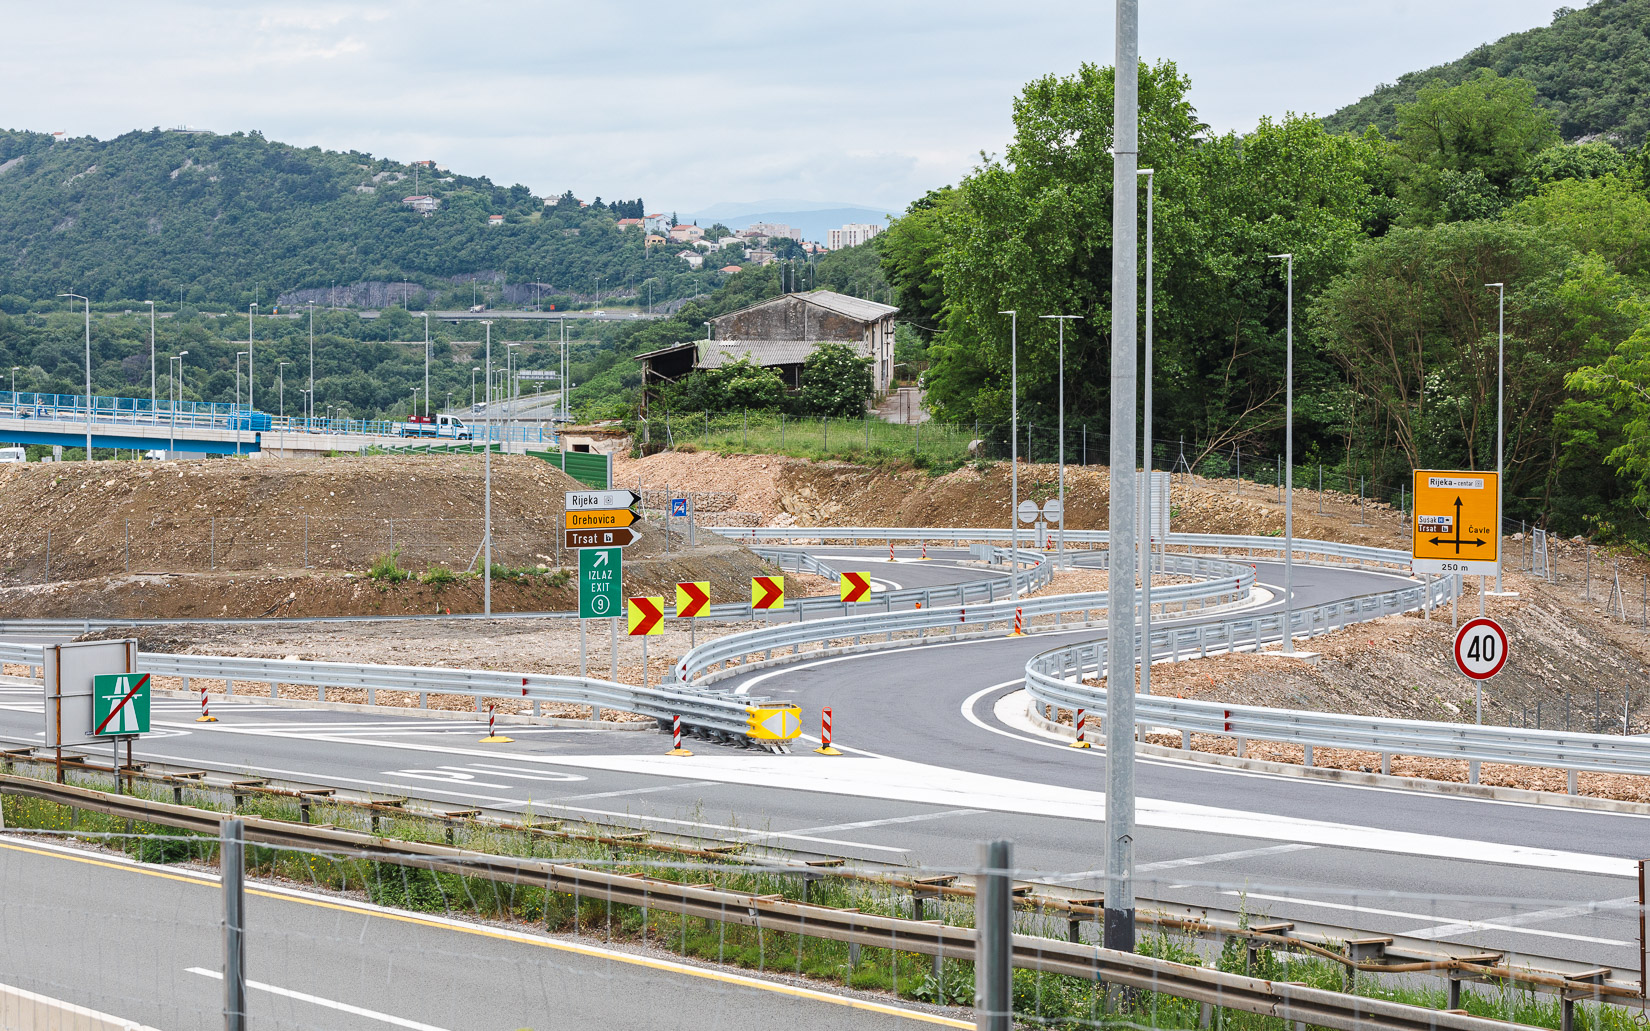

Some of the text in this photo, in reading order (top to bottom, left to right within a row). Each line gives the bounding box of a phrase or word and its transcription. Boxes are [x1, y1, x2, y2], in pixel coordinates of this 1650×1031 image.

[1430, 478, 1452, 487] Rijeka
[572, 495, 598, 507] Rijeka
[572, 514, 615, 525] Orehovica
[1469, 525, 1490, 534] Čavle
[572, 533, 597, 544] Trsat
[588, 570, 612, 580] IZLAZ
[591, 582, 610, 592] EXIT
[597, 598, 604, 610] 9
[1467, 634, 1495, 662] 40
